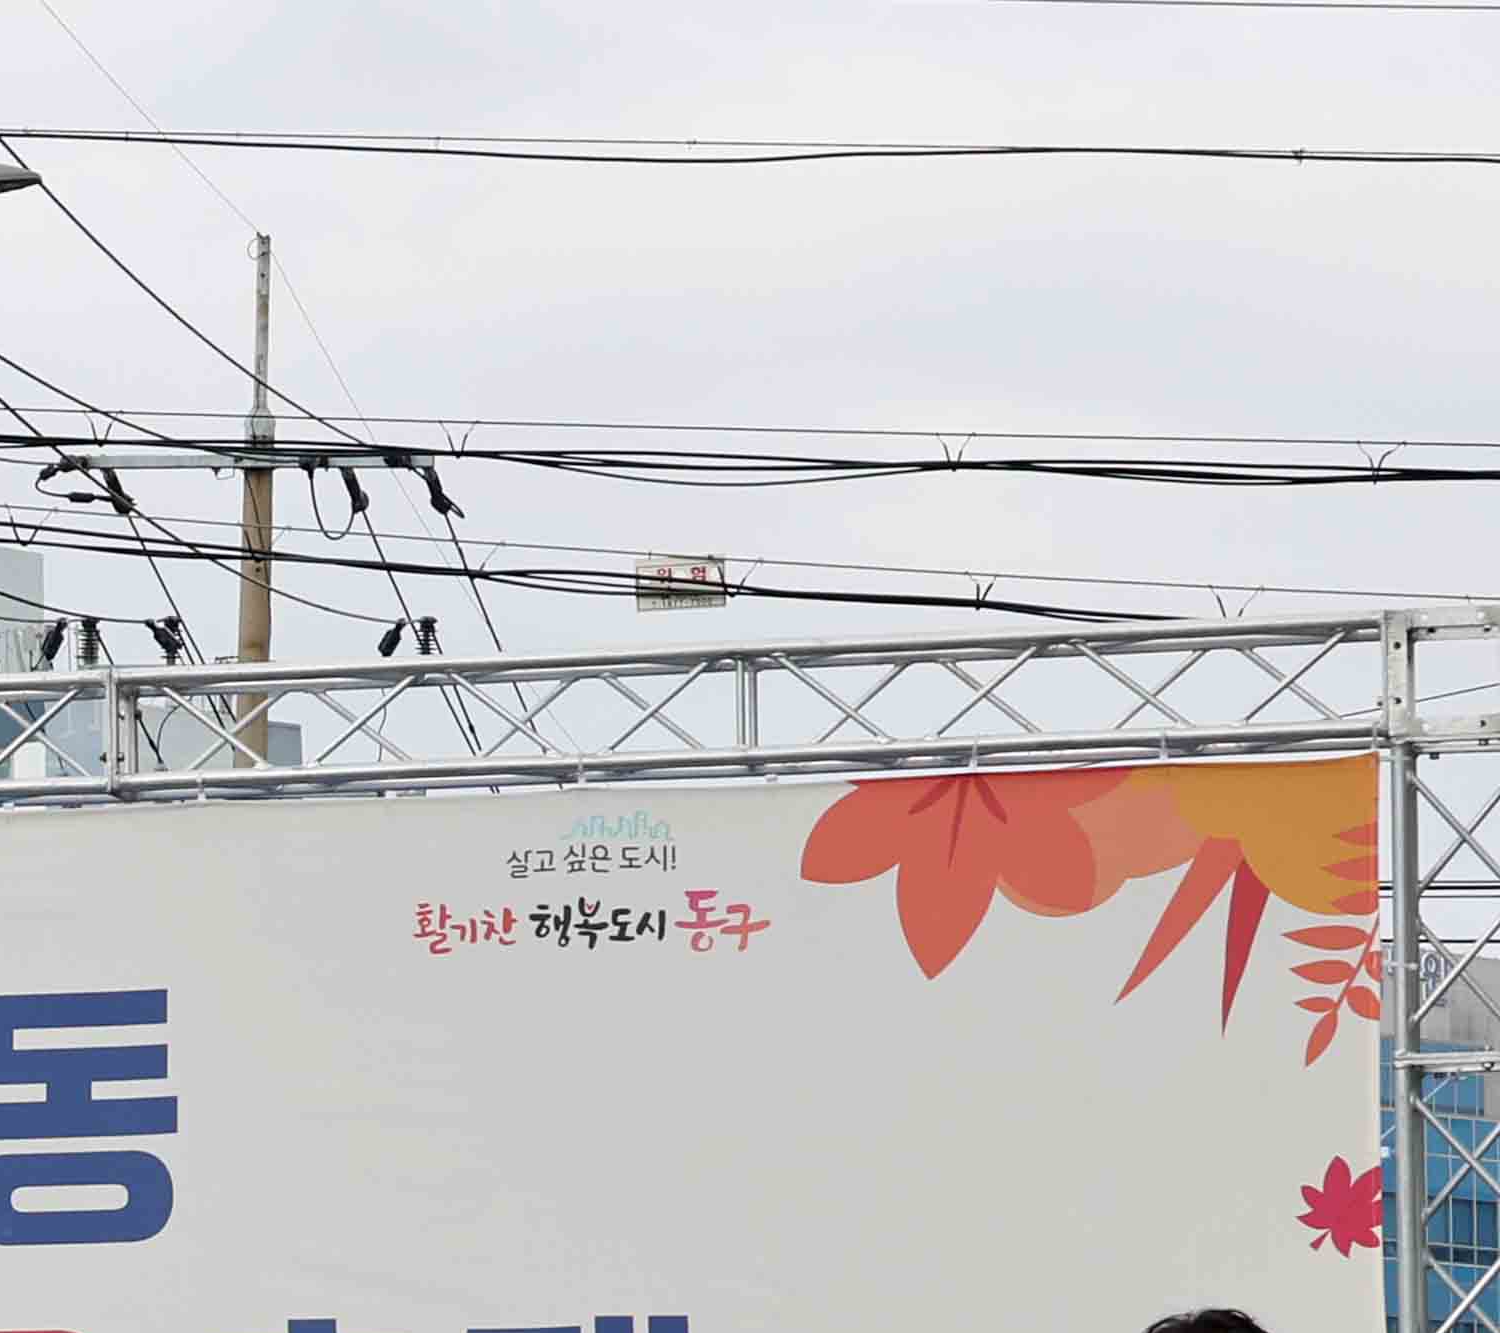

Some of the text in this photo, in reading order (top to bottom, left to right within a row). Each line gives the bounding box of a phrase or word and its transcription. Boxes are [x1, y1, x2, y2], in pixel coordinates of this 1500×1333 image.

[506, 844, 677, 879] 살고 싶은 도시!
[413, 889, 772, 955] 활기찬 행복도시 동구
